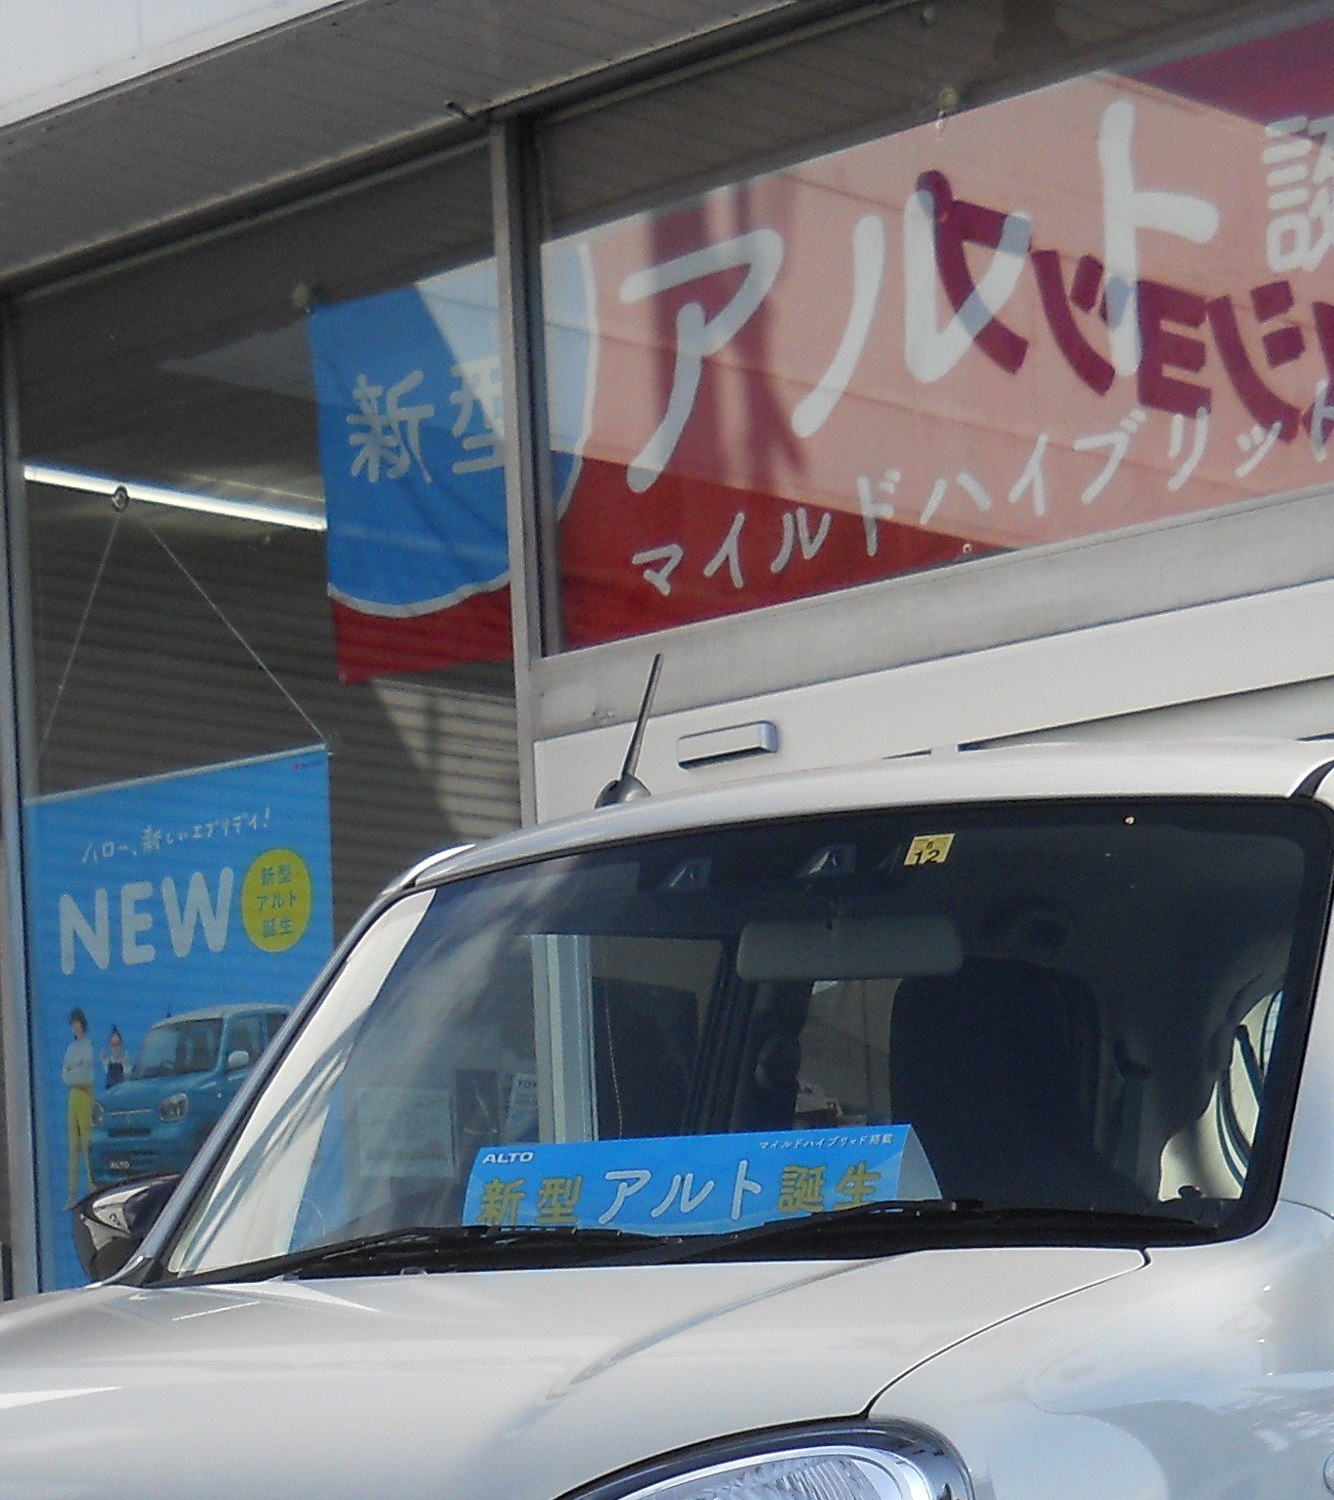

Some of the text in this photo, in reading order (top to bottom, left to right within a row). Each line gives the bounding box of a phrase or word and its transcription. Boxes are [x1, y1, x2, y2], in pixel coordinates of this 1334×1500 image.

[347, 358, 508, 484] 新型
[914, 849, 941, 866] 12
[260, 864, 294, 886] 新型
[255, 890, 298, 912] アルト
[59, 867, 234, 976] NEW
[261, 917, 294, 938] 誕生
[482, 1151, 534, 1165] ALTO
